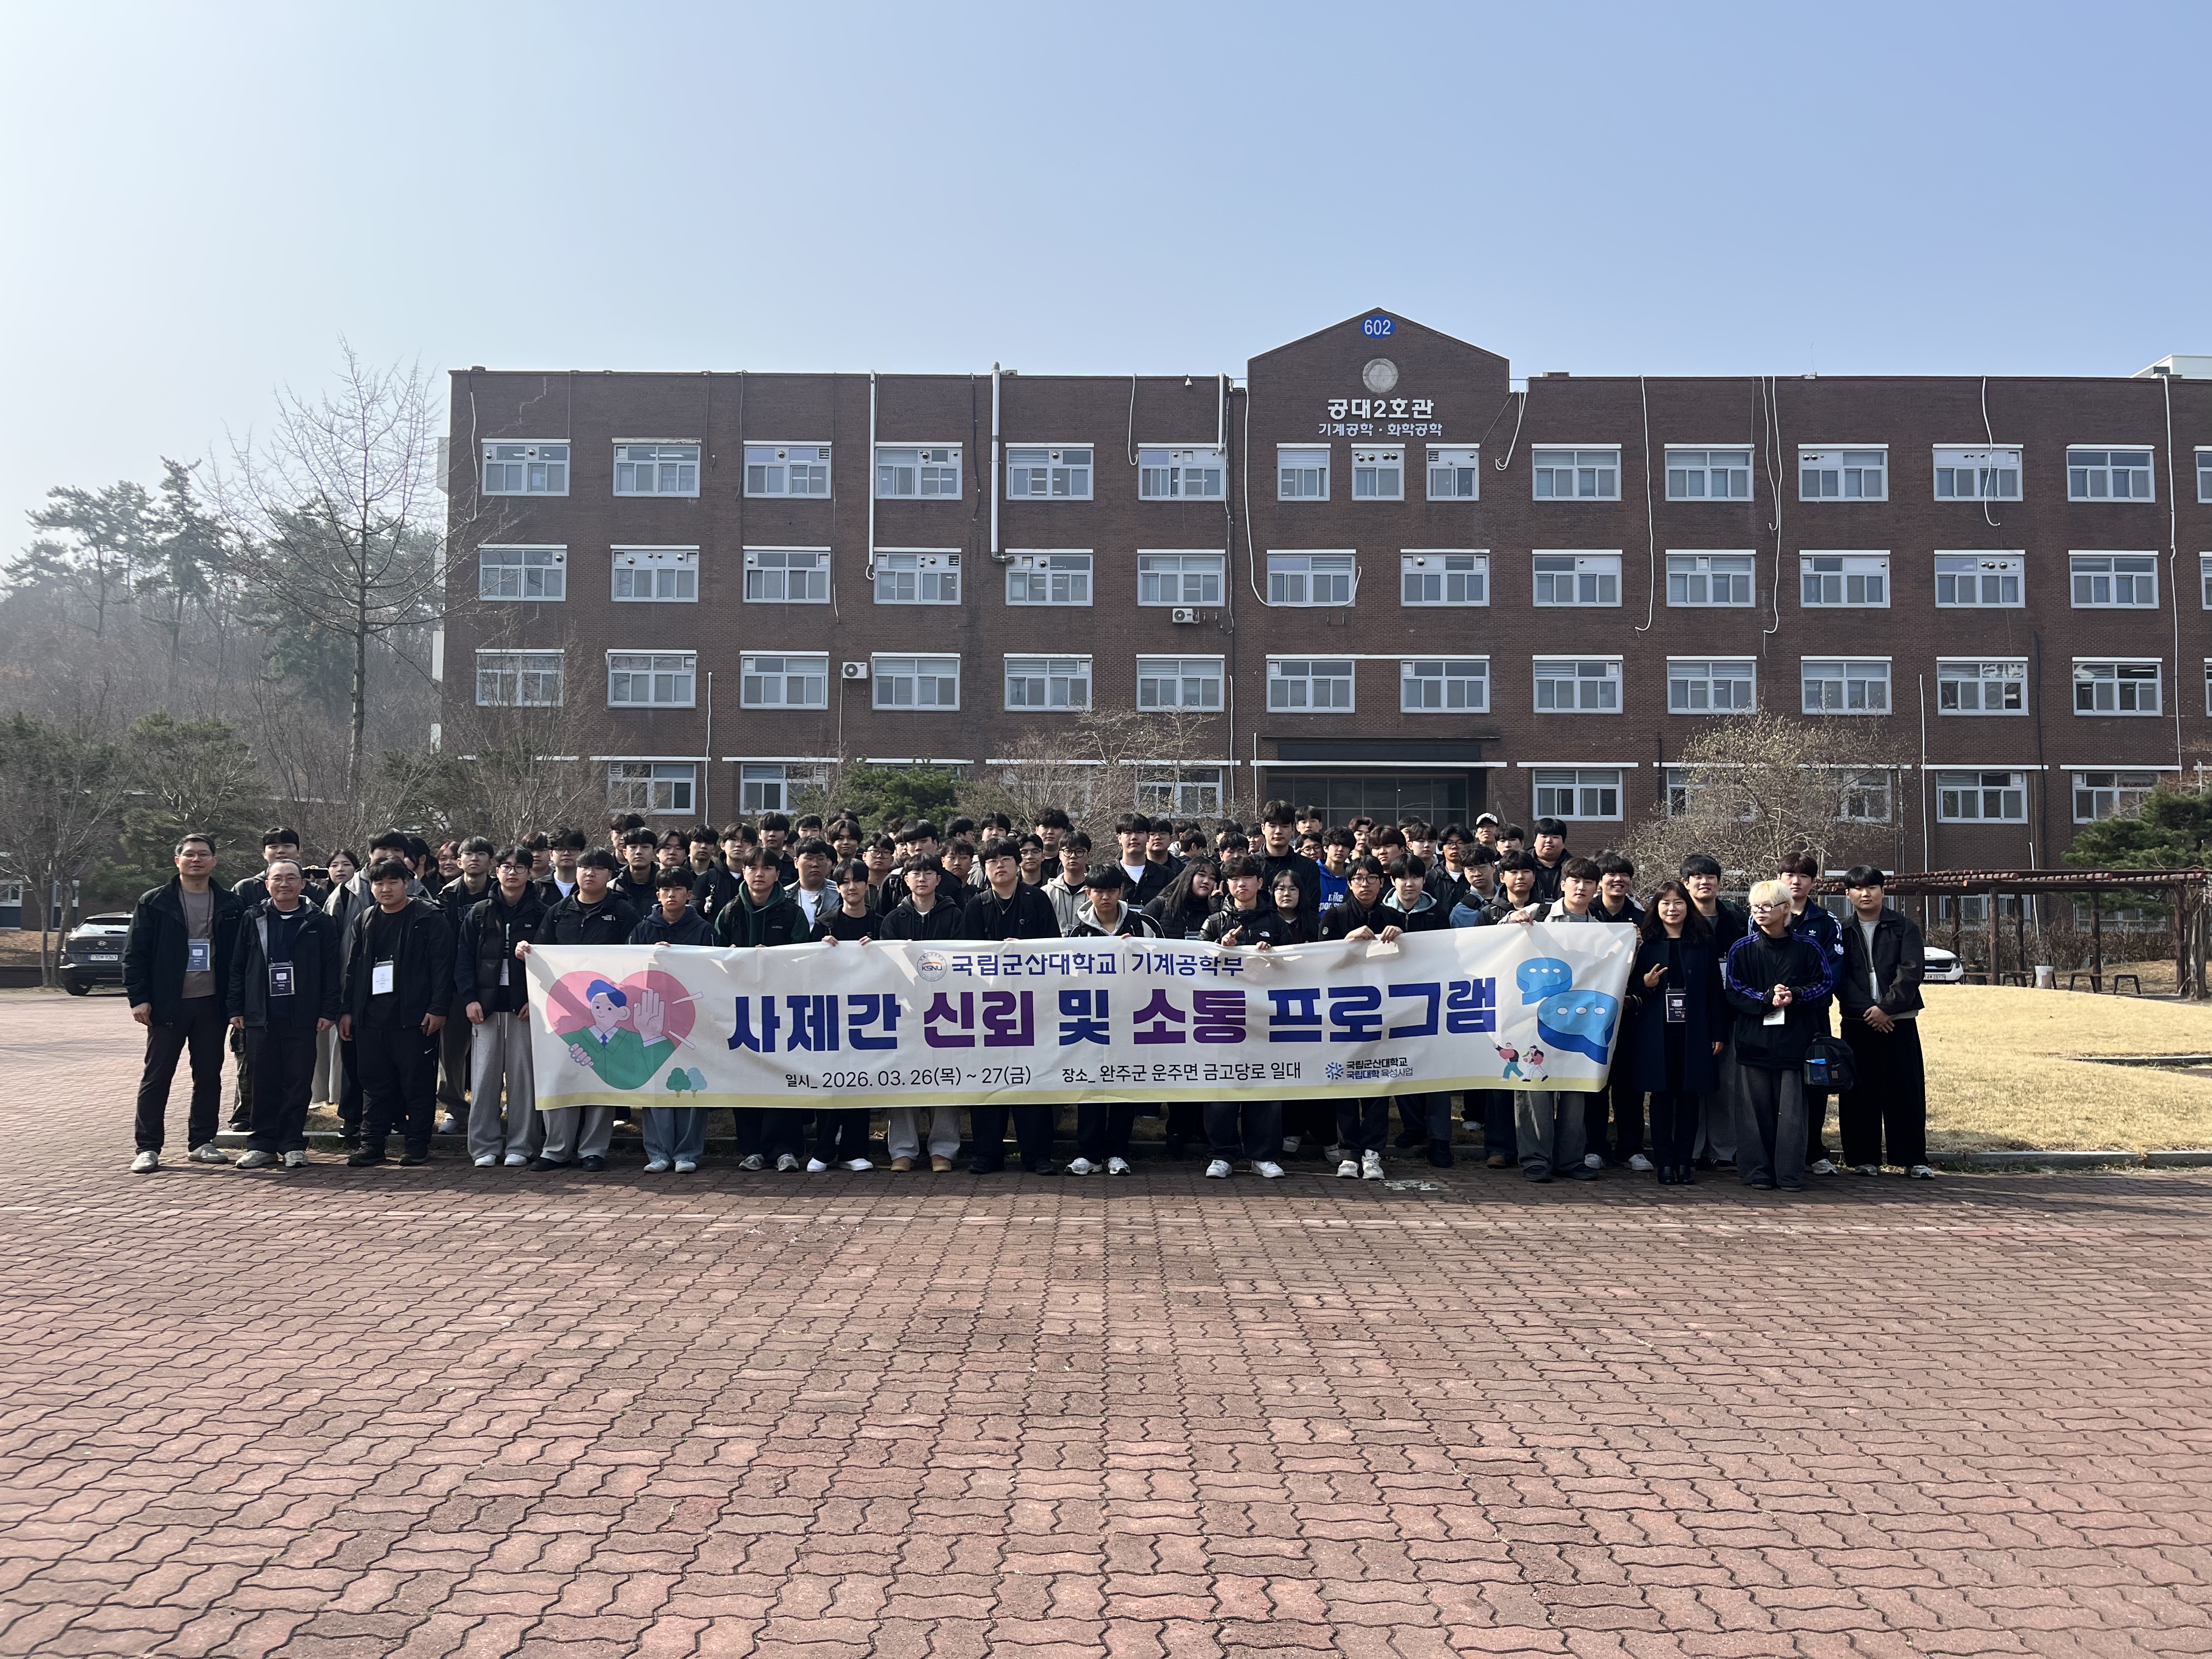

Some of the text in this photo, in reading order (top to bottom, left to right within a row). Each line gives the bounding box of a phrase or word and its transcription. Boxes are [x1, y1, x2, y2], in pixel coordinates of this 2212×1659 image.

[1364, 319, 1391, 335] 602
[1328, 398, 1434, 420] 공대2호관
[1318, 423, 1373, 437] 기계공학
[1387, 423, 1442, 437] 화학공학
[1328, 891, 1344, 902] nike
[951, 952, 1117, 976] 국립군산대학교
[1131, 952, 1244, 977] 기계공학부
[727, 977, 1496, 1053] 사제간 신뢰 및 소통 프로그램
[1099, 1064, 1148, 1082] 완주군
[1152, 1063, 1198, 1081] 운주면
[1203, 1063, 1266, 1081] 금고당로
[1271, 1062, 1302, 1080] 일대
[1346, 1057, 1408, 1069] 국립군산대학교
[822, 1071, 873, 1088] 2026.
[878, 1070, 905, 1086] 03.
[910, 1066, 962, 1086] 26(목)
[981, 1065, 1031, 1085] 27(금)
[1346, 1067, 1413, 1080] 국립대학 육성사업
